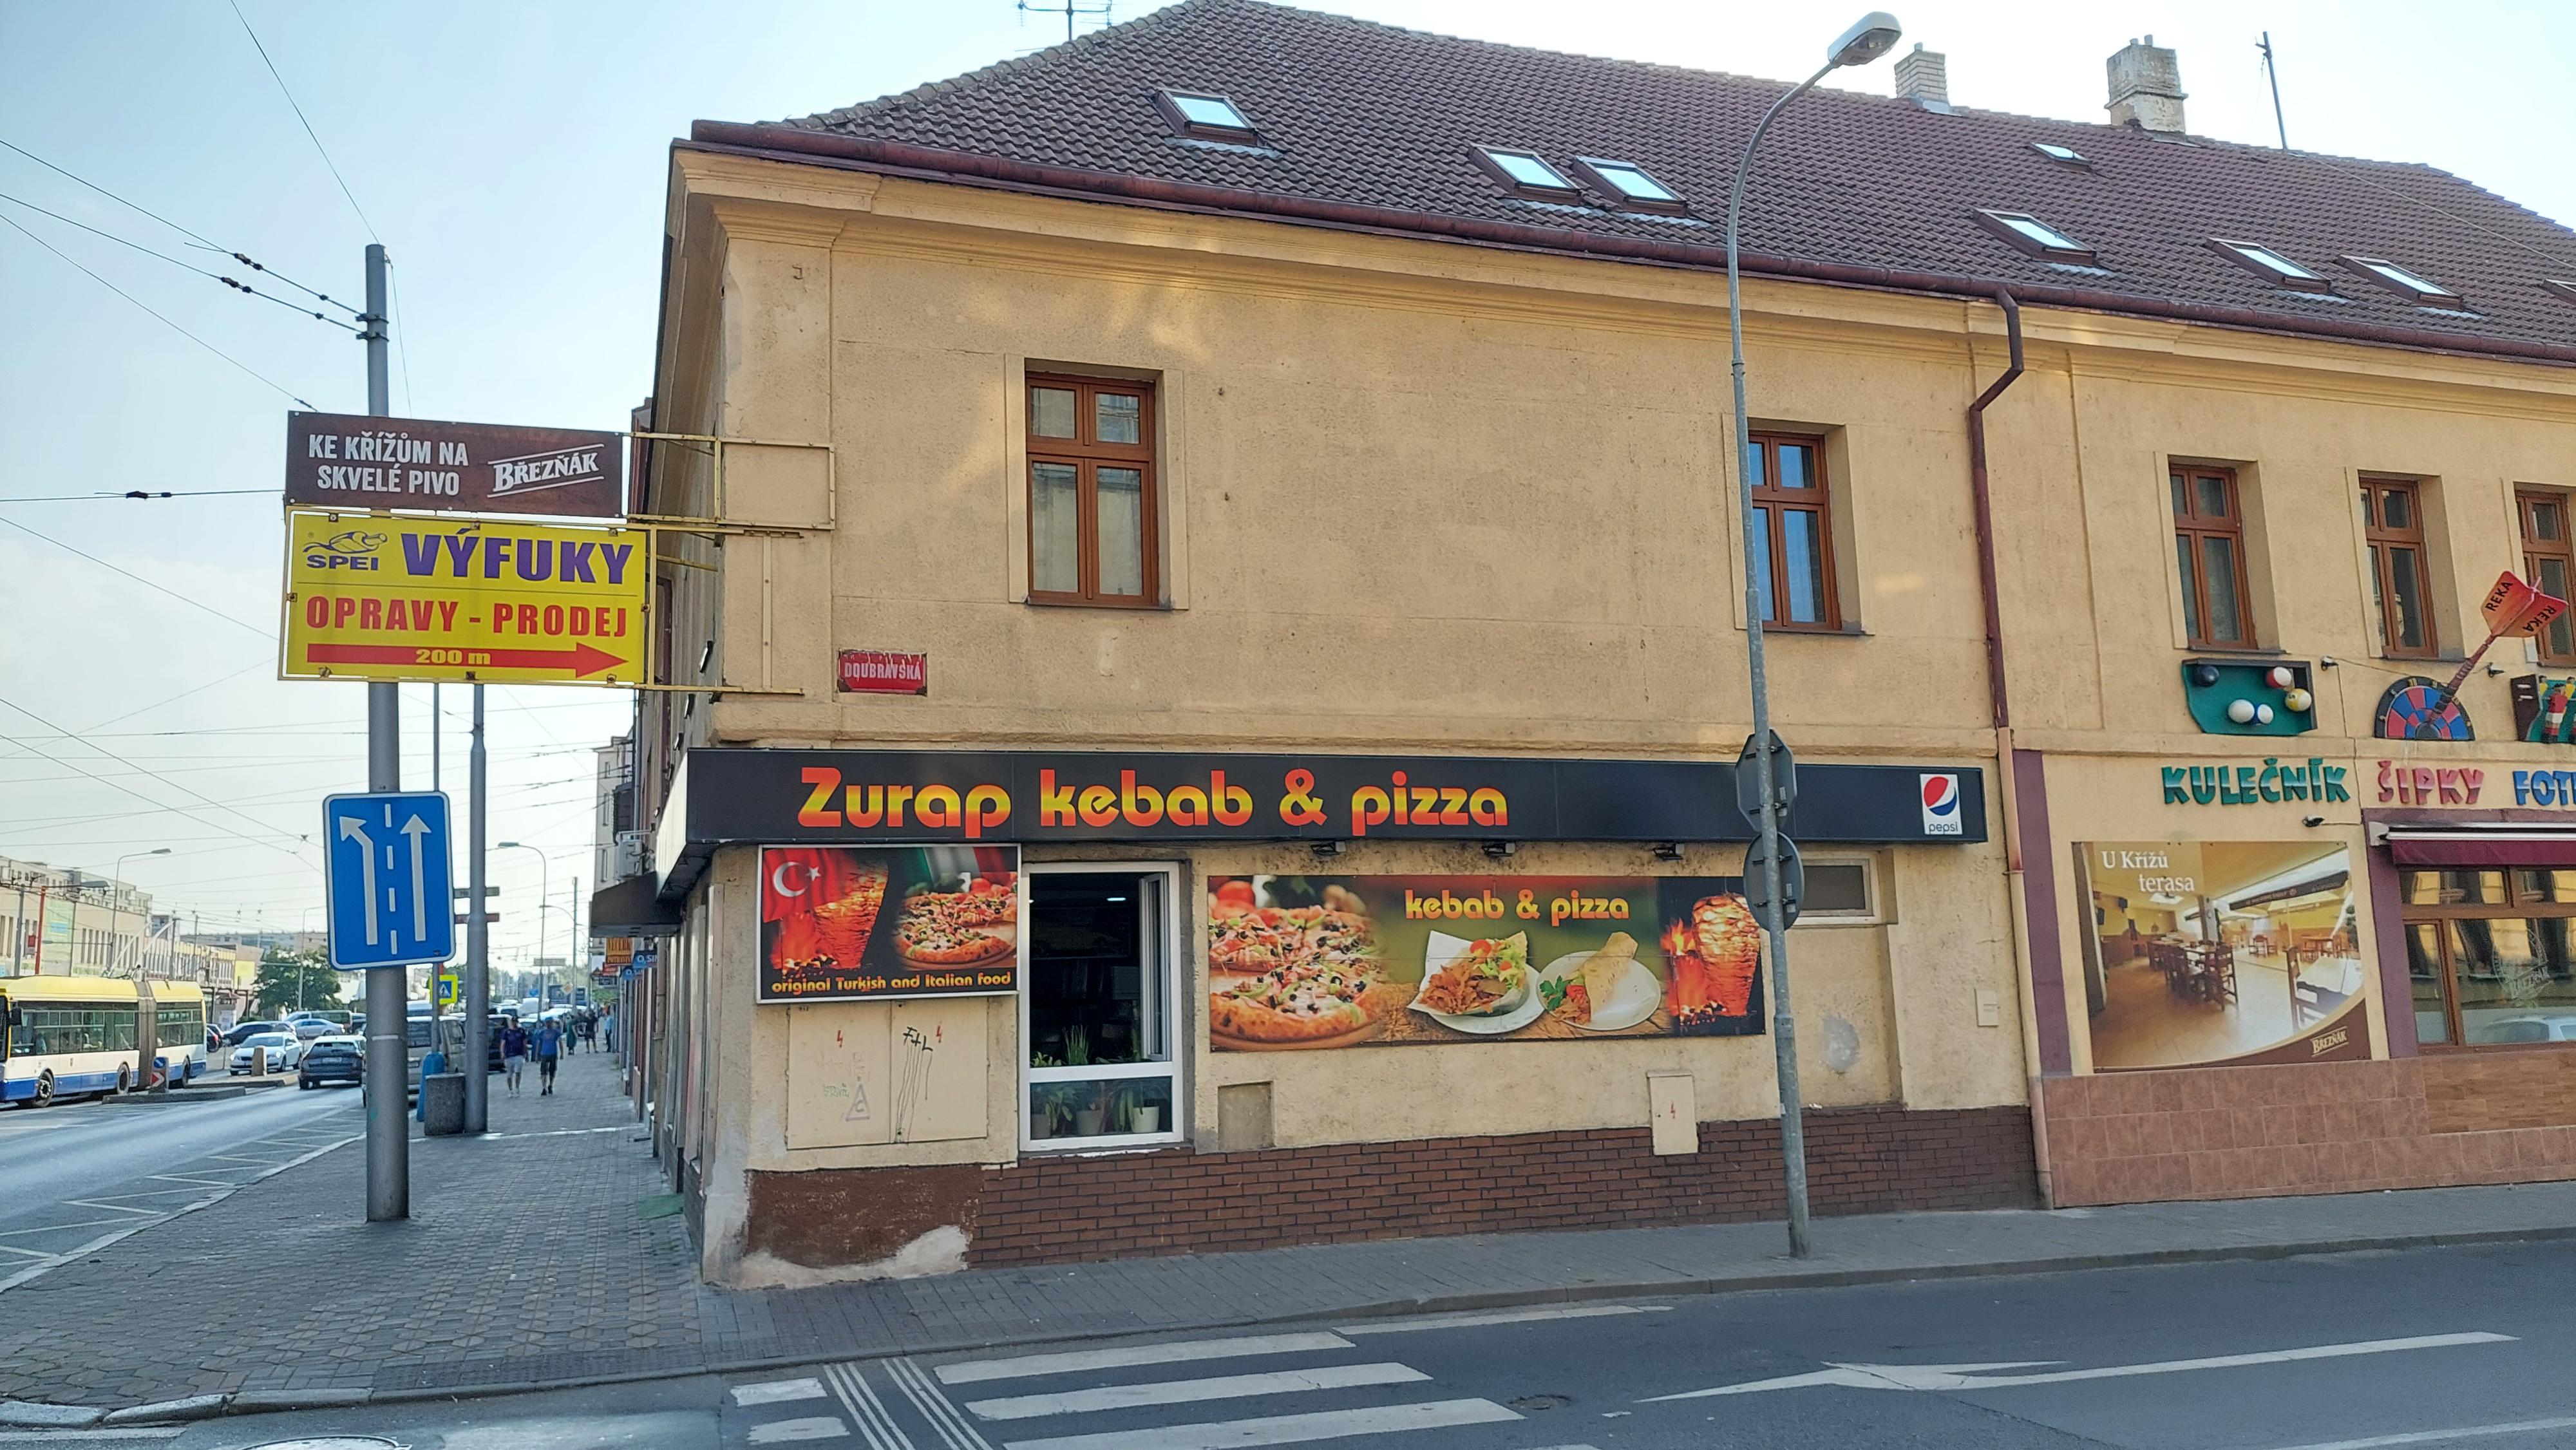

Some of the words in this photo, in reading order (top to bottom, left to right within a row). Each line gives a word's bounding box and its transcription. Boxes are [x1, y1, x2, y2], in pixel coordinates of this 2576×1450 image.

[308, 434, 337, 459] KE
[345, 430, 431, 464] KŘÍŽŮM
[439, 442, 469, 466] NA
[317, 463, 402, 493] SKVELÉ
[409, 470, 460, 496] PIVO
[493, 452, 600, 492] BŘEZŇÁK
[307, 555, 379, 570] SPEI
[401, 528, 634, 585] VÝFUKY
[2485, 581, 2514, 612] REKA
[307, 596, 459, 632] OPRAVY
[493, 603, 627, 637] PRODEJ
[2522, 605, 2557, 632] REKA
[415, 649, 463, 664] 200
[468, 652, 491, 665] m
[844, 662, 922, 681] DOUBRAVSKÁ
[2161, 757, 2351, 805] KULEČNÍK
[2378, 760, 2485, 805] ŠIPKY
[2512, 770, 2576, 806] FOT
[797, 767, 1012, 838] Zurap
[1040, 768, 1254, 827] kebab
[1279, 768, 1327, 827] &
[1351, 771, 1508, 836] pizza
[1929, 821, 1958, 834] pepsi
[2101, 851, 2116, 869] U
[2121, 850, 2169, 869] Křížů
[2139, 873, 2195, 892] terasa
[1405, 889, 1505, 919] kebab
[1515, 889, 1540, 919] &
[1551, 890, 1629, 927] pizza
[772, 977, 831, 995] original
[837, 975, 886, 992] Turkish
[891, 975, 920, 988] and
[925, 973, 973, 988] Italian
[978, 971, 1012, 986] food
